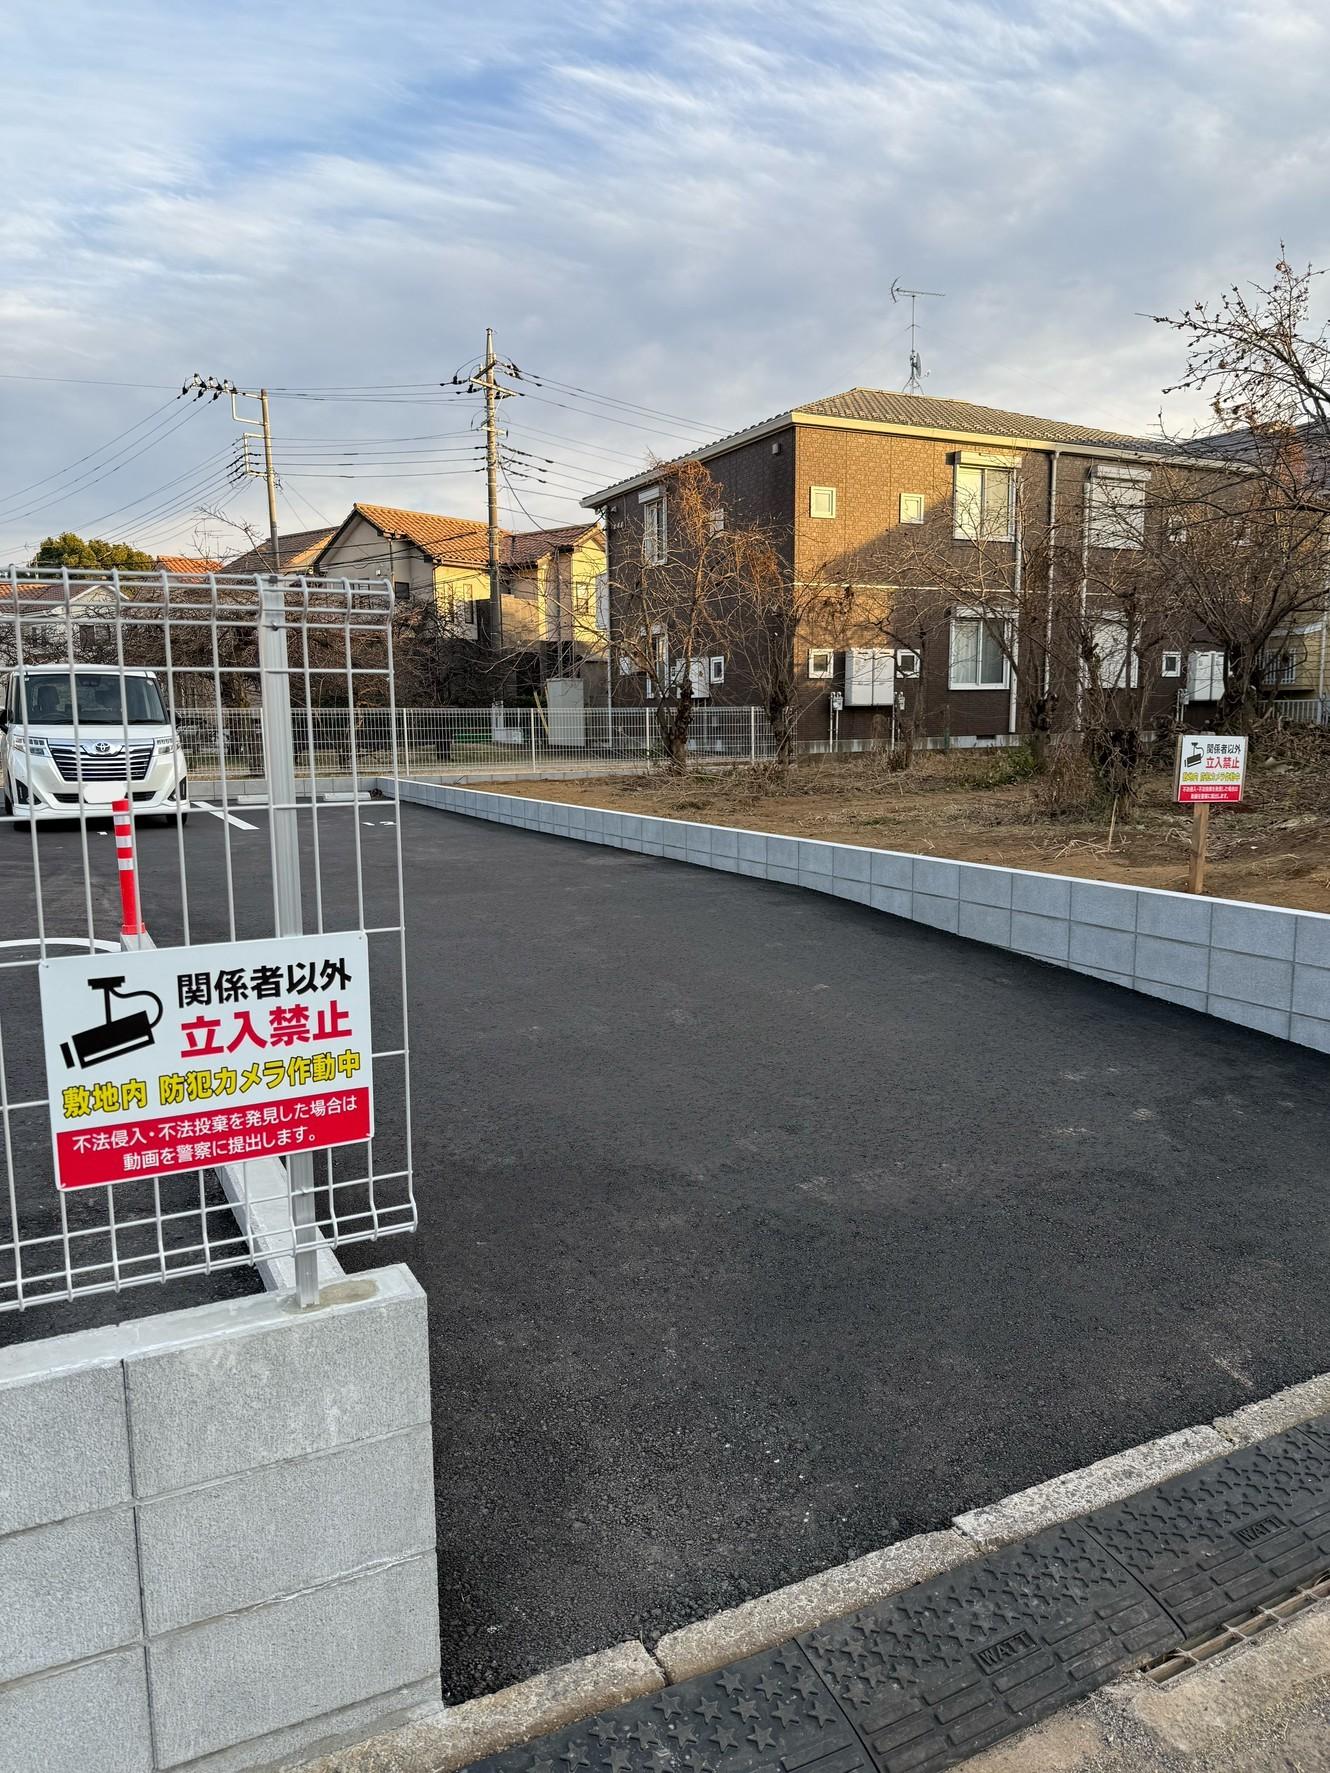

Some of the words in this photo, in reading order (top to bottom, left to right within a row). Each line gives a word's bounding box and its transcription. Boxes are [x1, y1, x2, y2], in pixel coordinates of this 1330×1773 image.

[1205, 756, 1240, 769] 立入禁止
[1206, 743, 1241, 755] 関係者以外
[176, 957, 352, 1009] 関係者以外
[180, 999, 353, 1059] 立入禁止
[62, 1078, 148, 1119] 敷地内
[159, 1049, 361, 1105] 防犯カメラ作動中
[71, 1095, 358, 1154] 不法侵入・不法投棄を発見した場合は
[123, 1132, 316, 1171] 動画を警察に提出します。
[977, 1632, 1031, 1667] WATT
